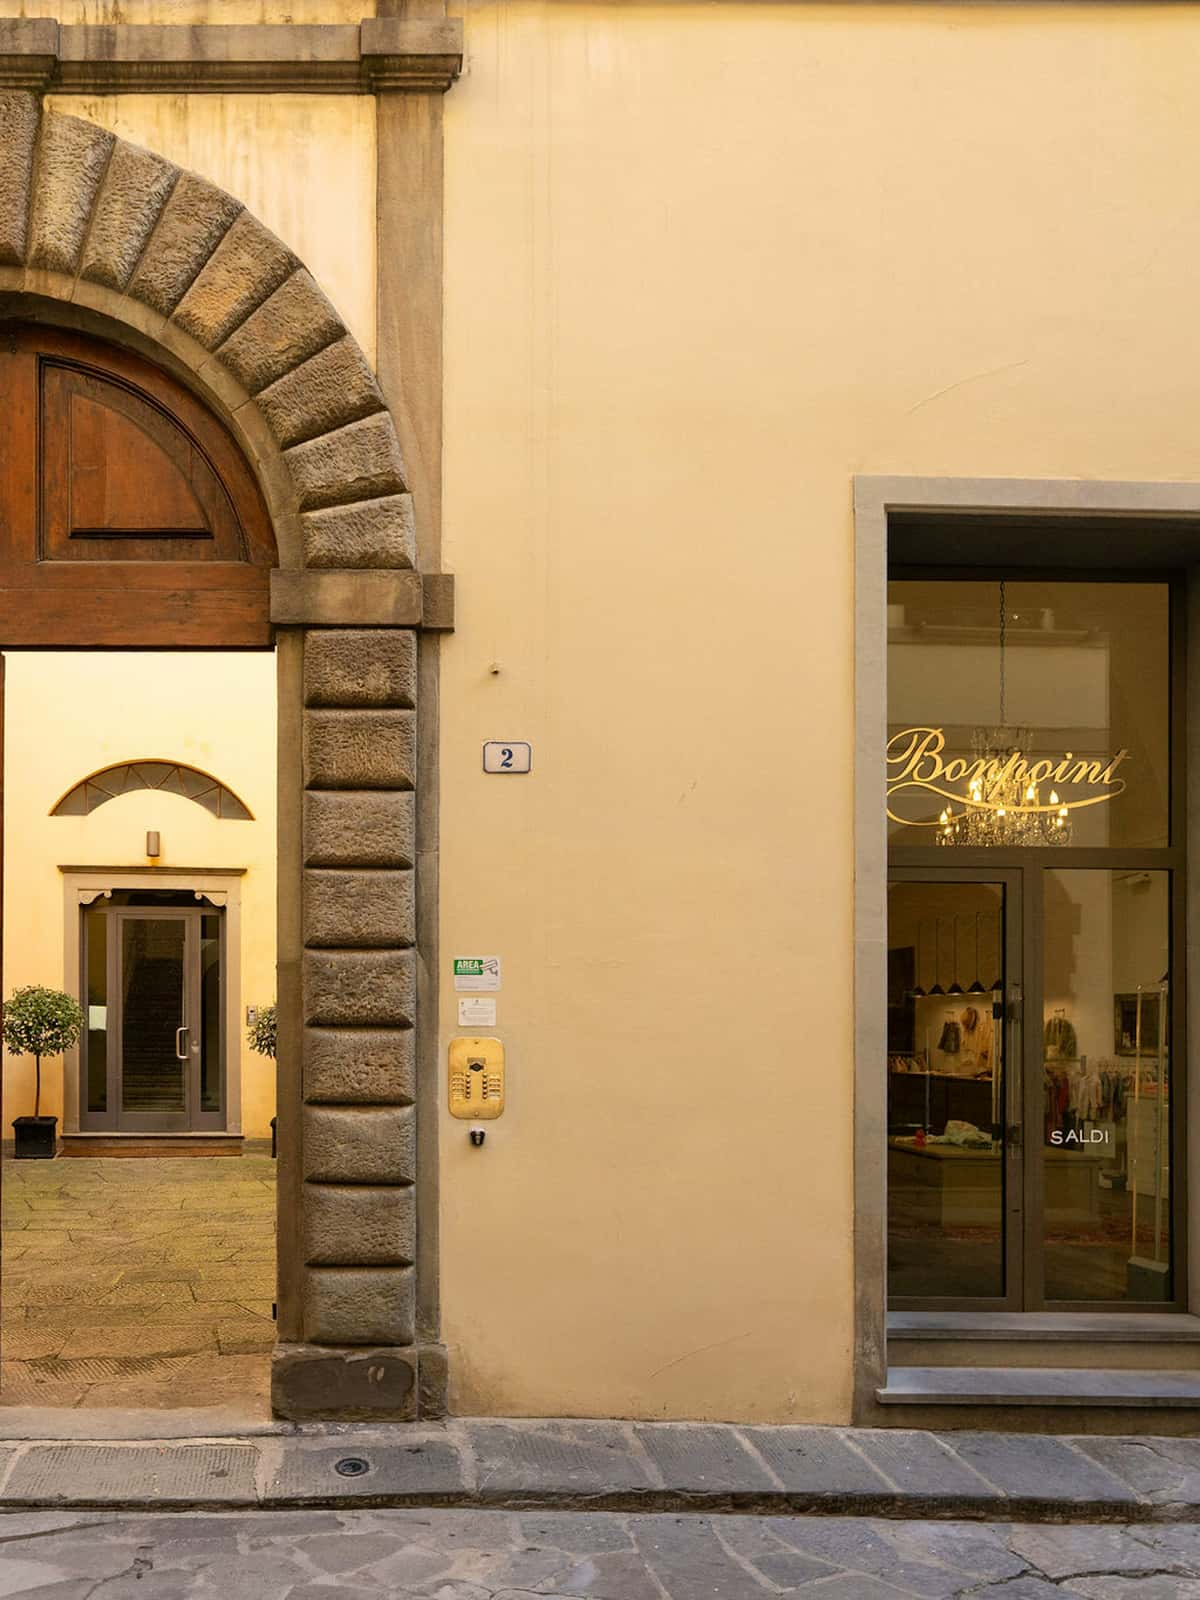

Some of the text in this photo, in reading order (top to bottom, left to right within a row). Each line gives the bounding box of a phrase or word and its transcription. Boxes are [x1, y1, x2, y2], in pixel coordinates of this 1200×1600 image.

[500, 748, 513, 768] 2
[887, 727, 1132, 803] Bonpoint
[456, 960, 479, 969] AREA
[1050, 1129, 1109, 1145] SALDI
